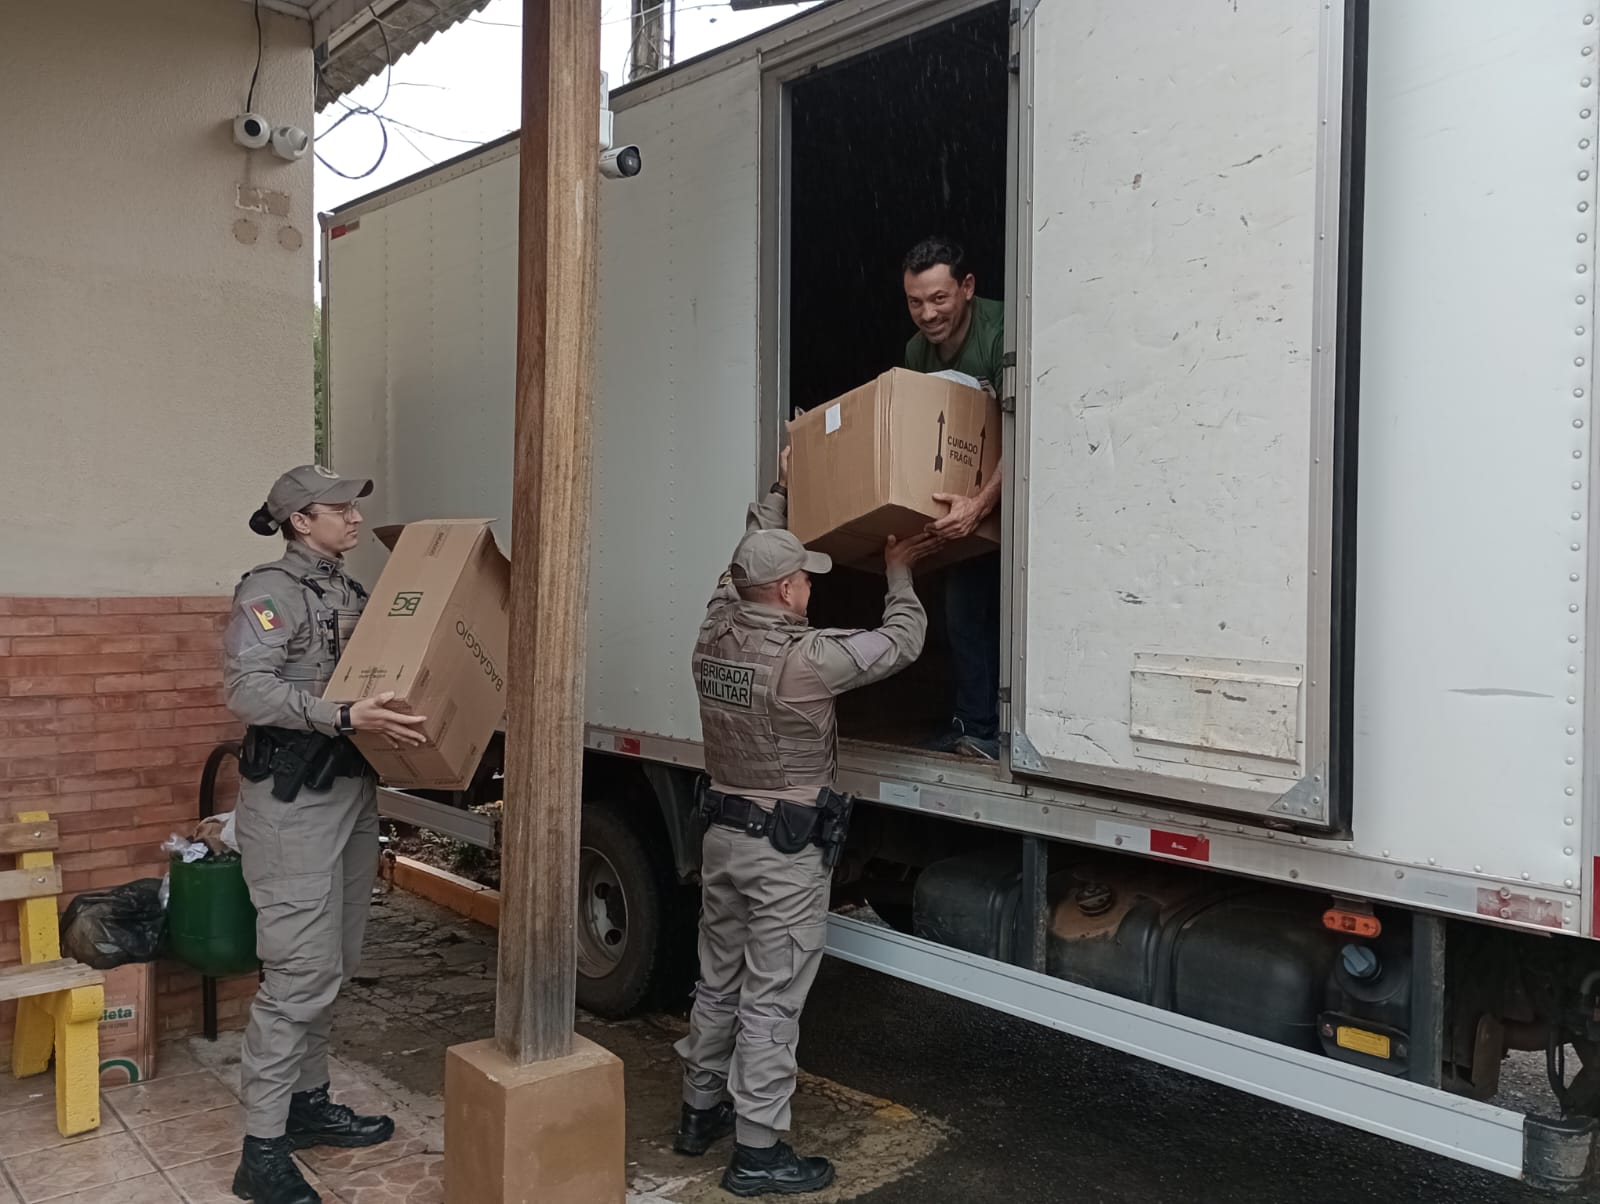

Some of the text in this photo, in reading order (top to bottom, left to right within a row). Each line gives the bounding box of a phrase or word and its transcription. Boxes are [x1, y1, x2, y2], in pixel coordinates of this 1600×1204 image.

[947, 435, 978, 455] CUIDADO
[390, 594, 422, 614] BG
[456, 620, 504, 692] BAGAGGIO
[704, 663, 749, 686] BRIGADA
[703, 679, 749, 703] MILITAR
[98, 1007, 132, 1021] leta
